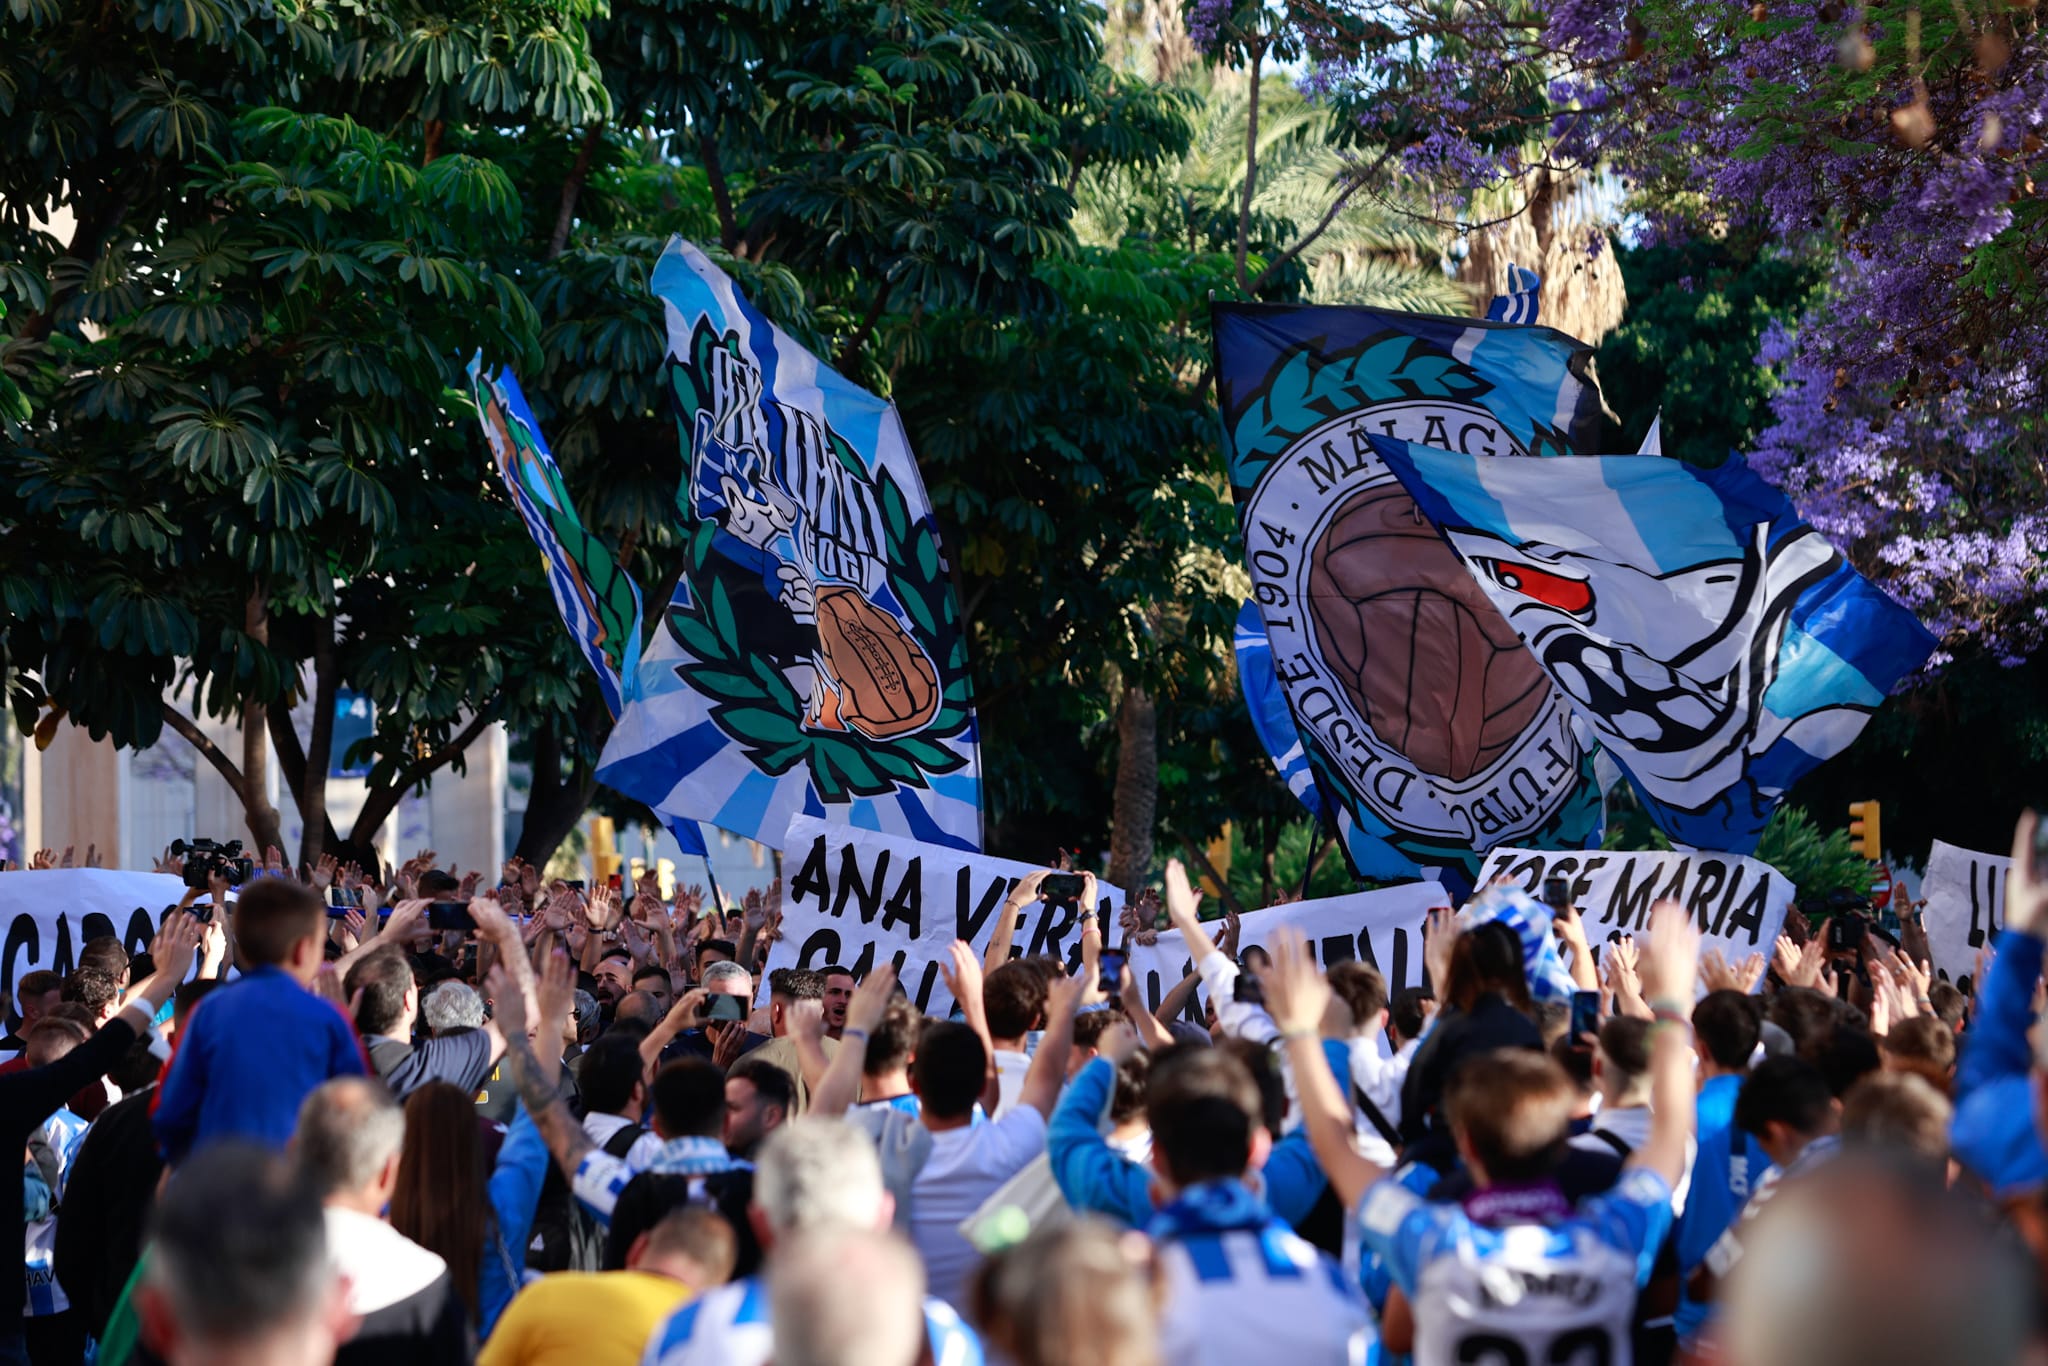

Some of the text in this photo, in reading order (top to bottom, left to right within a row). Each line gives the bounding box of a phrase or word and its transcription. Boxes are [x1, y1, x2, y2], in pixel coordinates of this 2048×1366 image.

[1253, 520, 1295, 632] 1904
[1278, 652, 1416, 812] DESDE
[791, 834, 921, 940] ANA
[1600, 856, 1770, 945] MARIA
